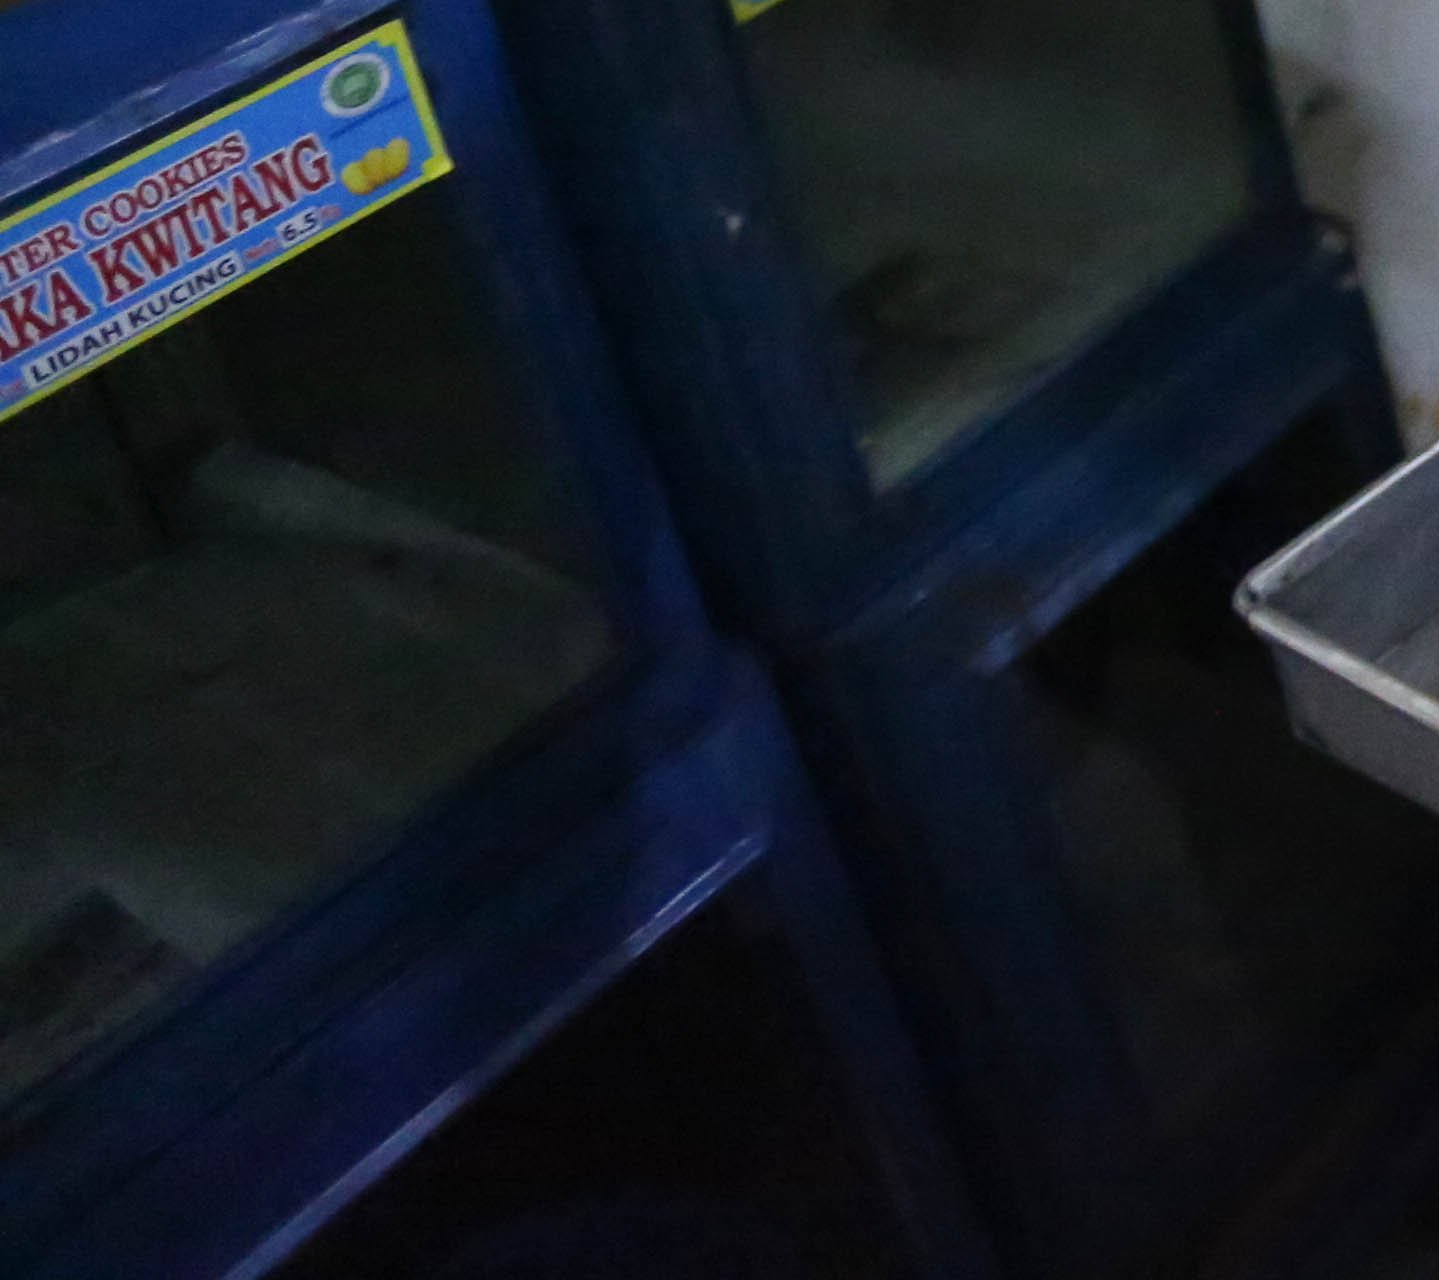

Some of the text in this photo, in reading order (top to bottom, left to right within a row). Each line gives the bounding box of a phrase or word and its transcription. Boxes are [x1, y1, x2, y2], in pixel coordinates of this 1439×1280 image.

[84, 134, 247, 237] COOKIES
[88, 136, 332, 303] KWITANG
[30, 212, 318, 383] LIDAH KUCING 6.5
